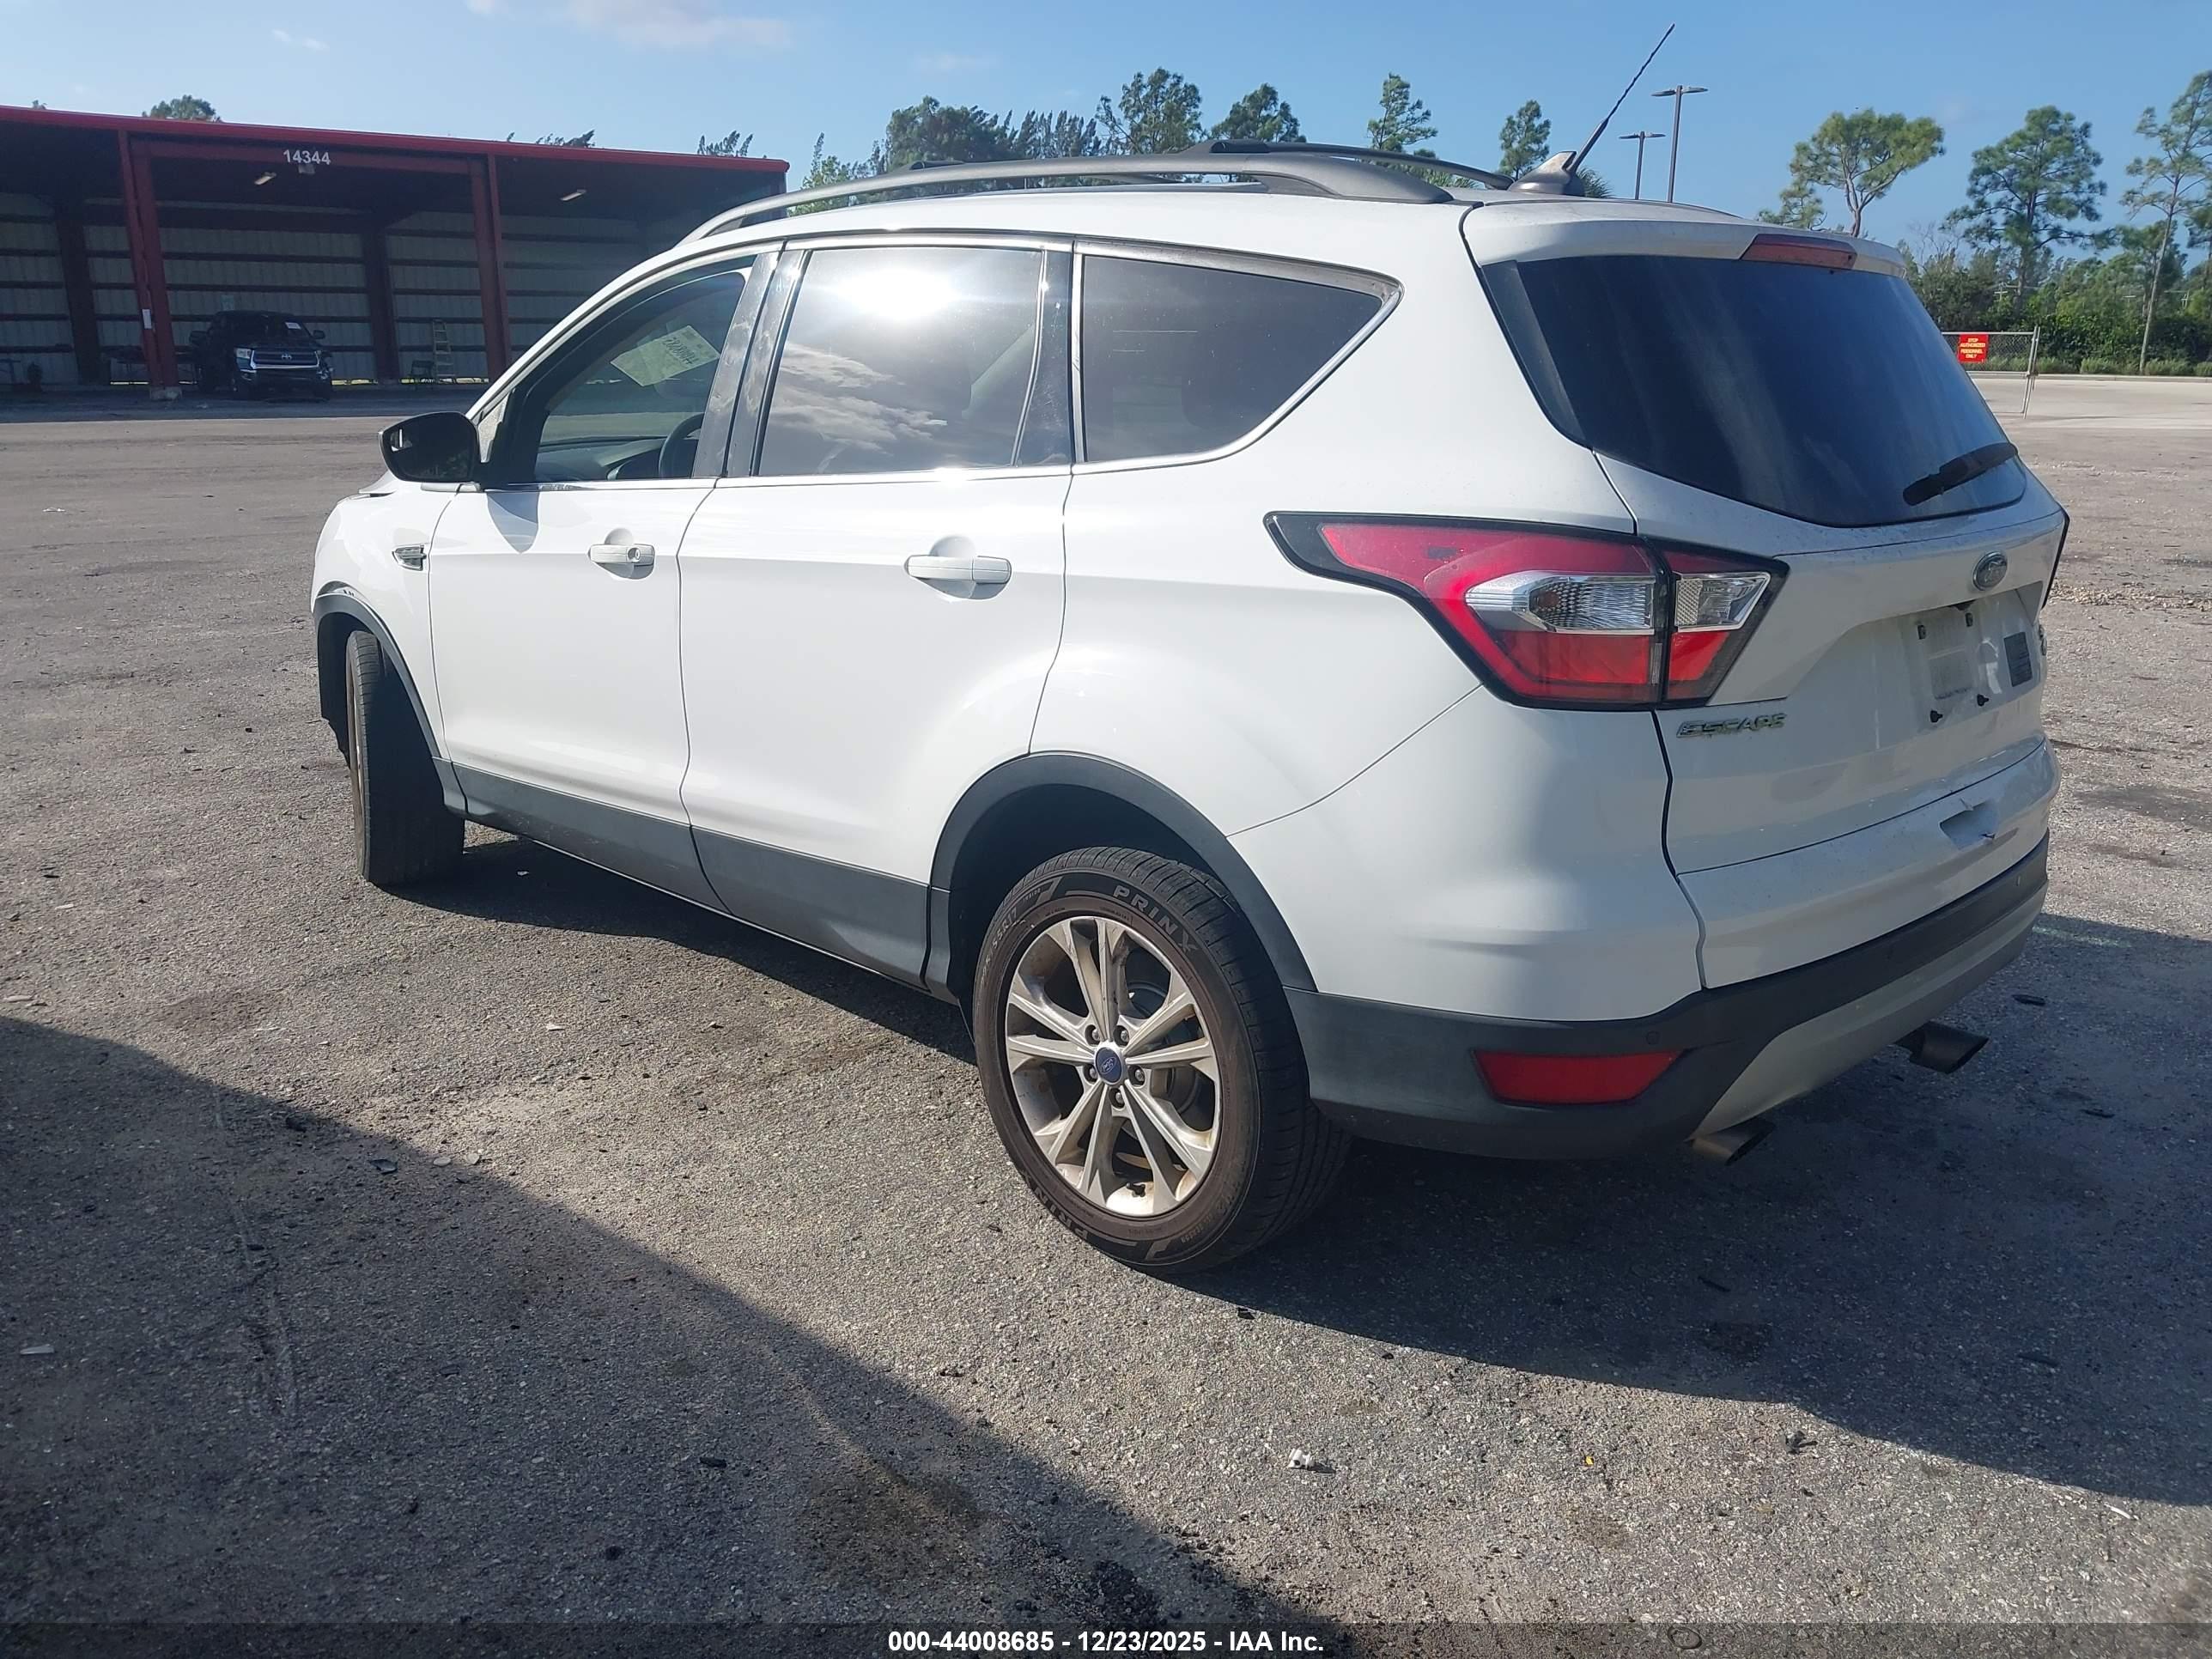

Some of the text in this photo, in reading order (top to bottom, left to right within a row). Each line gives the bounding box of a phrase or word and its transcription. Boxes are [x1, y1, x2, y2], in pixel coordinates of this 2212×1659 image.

[283, 149, 331, 166] 14344
[1676, 713, 1787, 738] ESCAPE
[1113, 884, 1199, 952] PRINX
